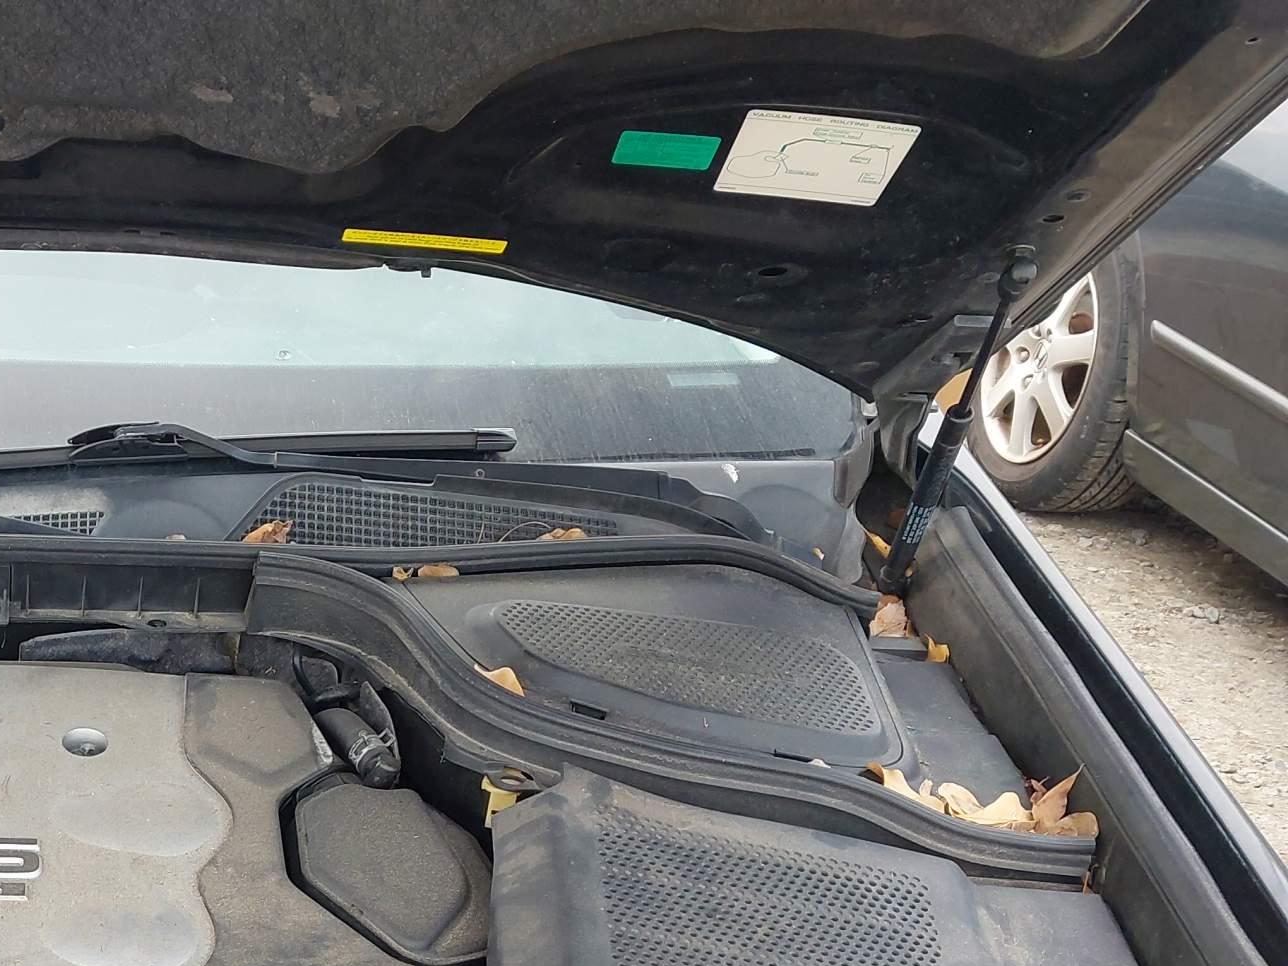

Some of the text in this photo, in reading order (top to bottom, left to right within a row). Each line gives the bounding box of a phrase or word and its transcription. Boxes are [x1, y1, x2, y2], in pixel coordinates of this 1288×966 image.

[752, 111, 792, 120] VACUUM
[830, 119, 869, 128] ROUTING
[876, 124, 919, 133] DIAGRAM
